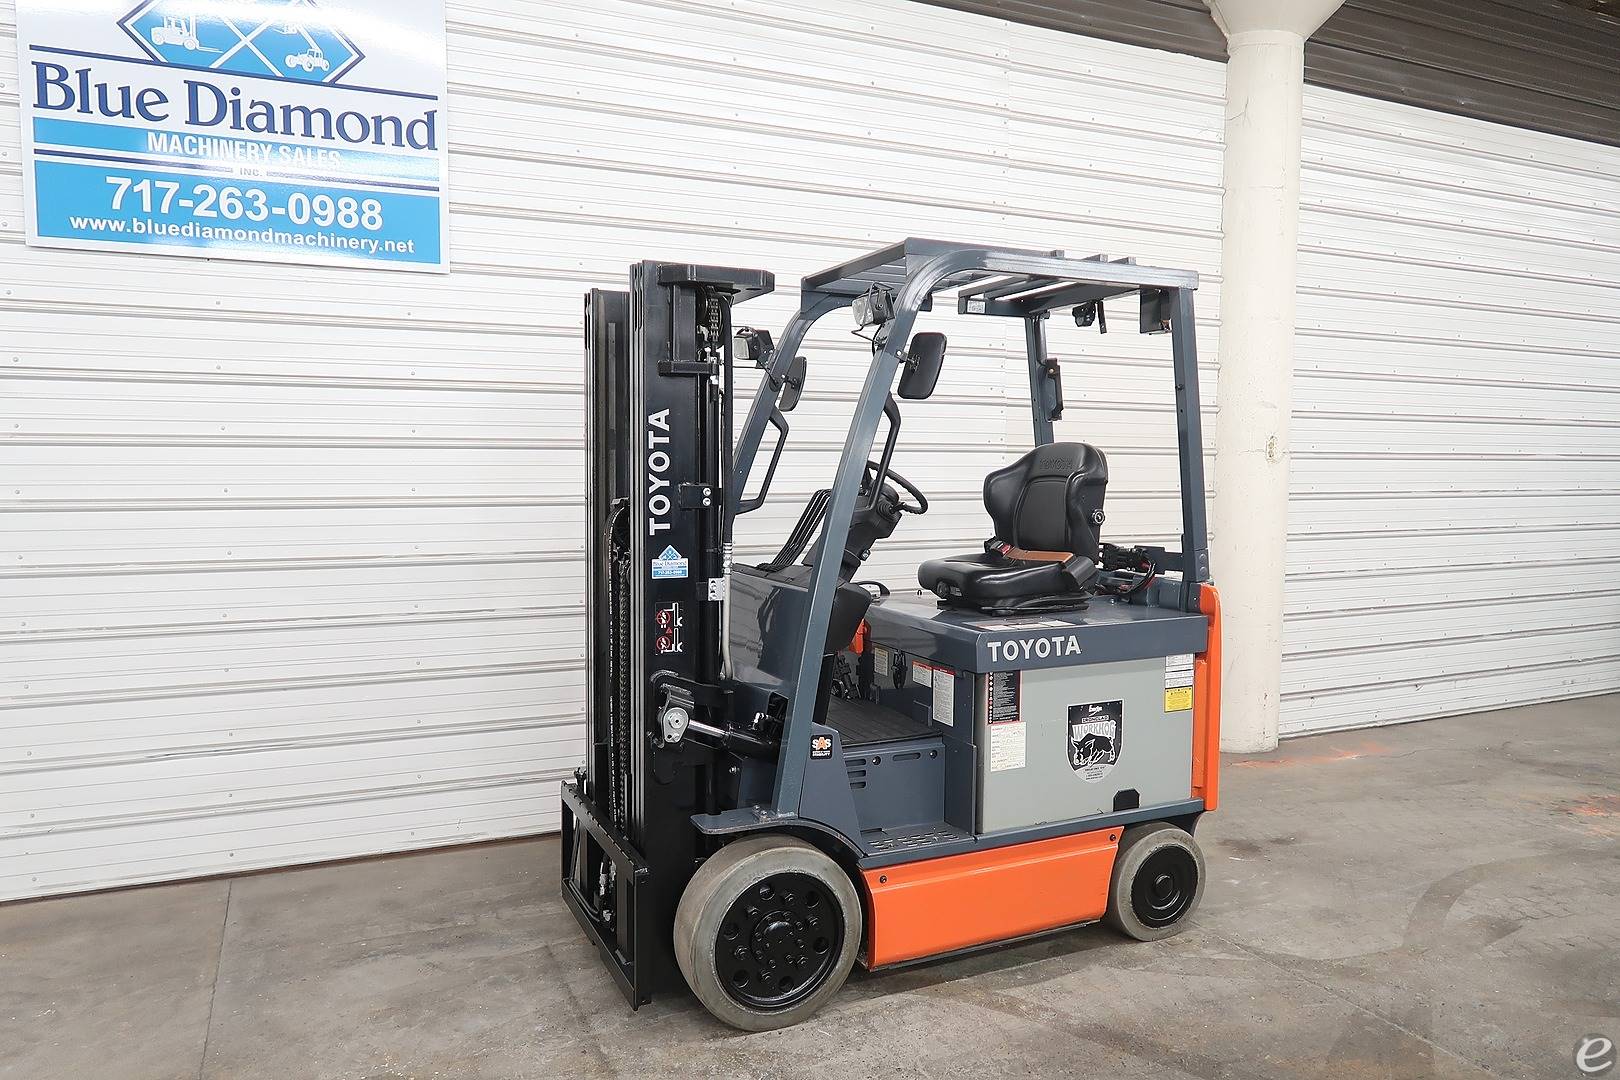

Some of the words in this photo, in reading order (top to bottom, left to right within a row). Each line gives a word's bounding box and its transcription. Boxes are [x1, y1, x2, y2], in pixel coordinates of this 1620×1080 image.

[31, 60, 170, 122] Blue
[183, 79, 439, 151] Diamond
[147, 131, 273, 165] MACHINERY
[278, 145, 342, 168] SALES
[105, 175, 384, 231] 717-263-0988
[69, 214, 416, 254] www.bluediamondmachinery.net
[648, 408, 671, 536] TOYOTA
[987, 635, 1082, 662] TOYOTA
[812, 736, 832, 750] SAS
